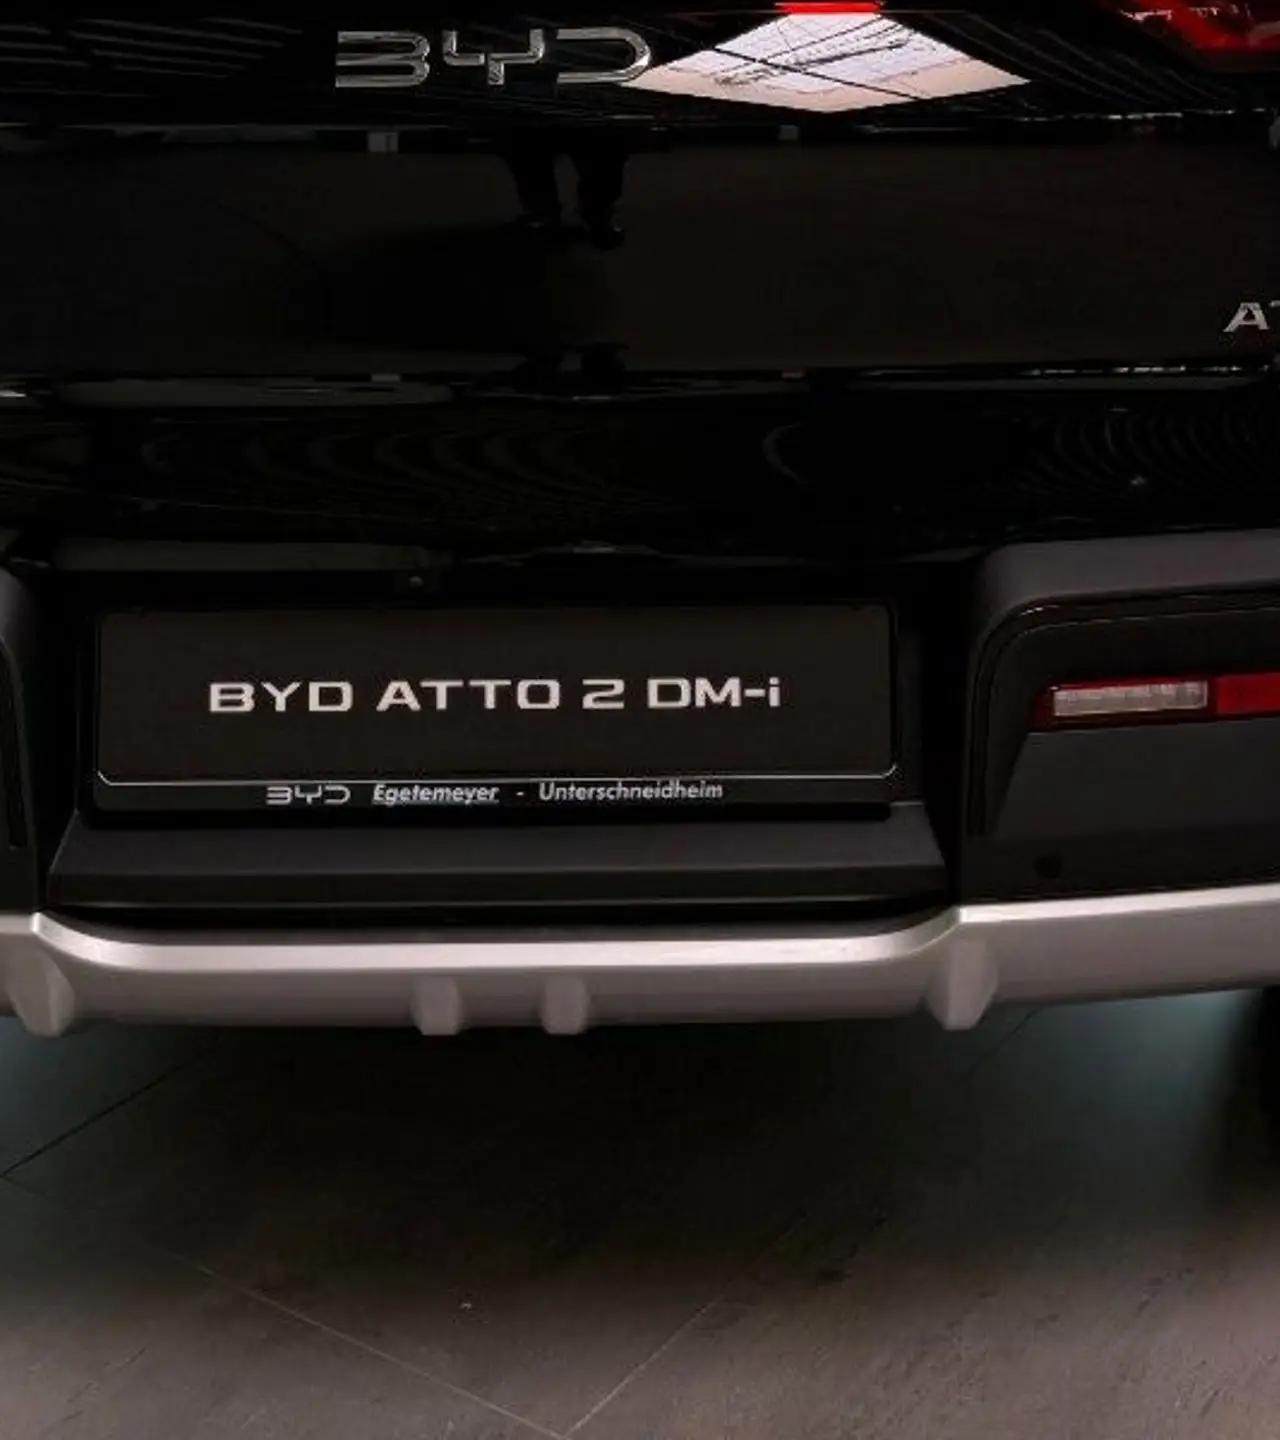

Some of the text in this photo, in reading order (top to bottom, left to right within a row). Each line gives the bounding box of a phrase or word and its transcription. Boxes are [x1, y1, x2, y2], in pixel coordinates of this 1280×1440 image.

[335, 28, 652, 88] BYD
[209, 677, 780, 713] BYD ATTO 2 DM-i
[266, 784, 351, 805] BYD
[372, 782, 500, 806] Egetemeyer
[539, 781, 723, 801] Unterschneidheim
